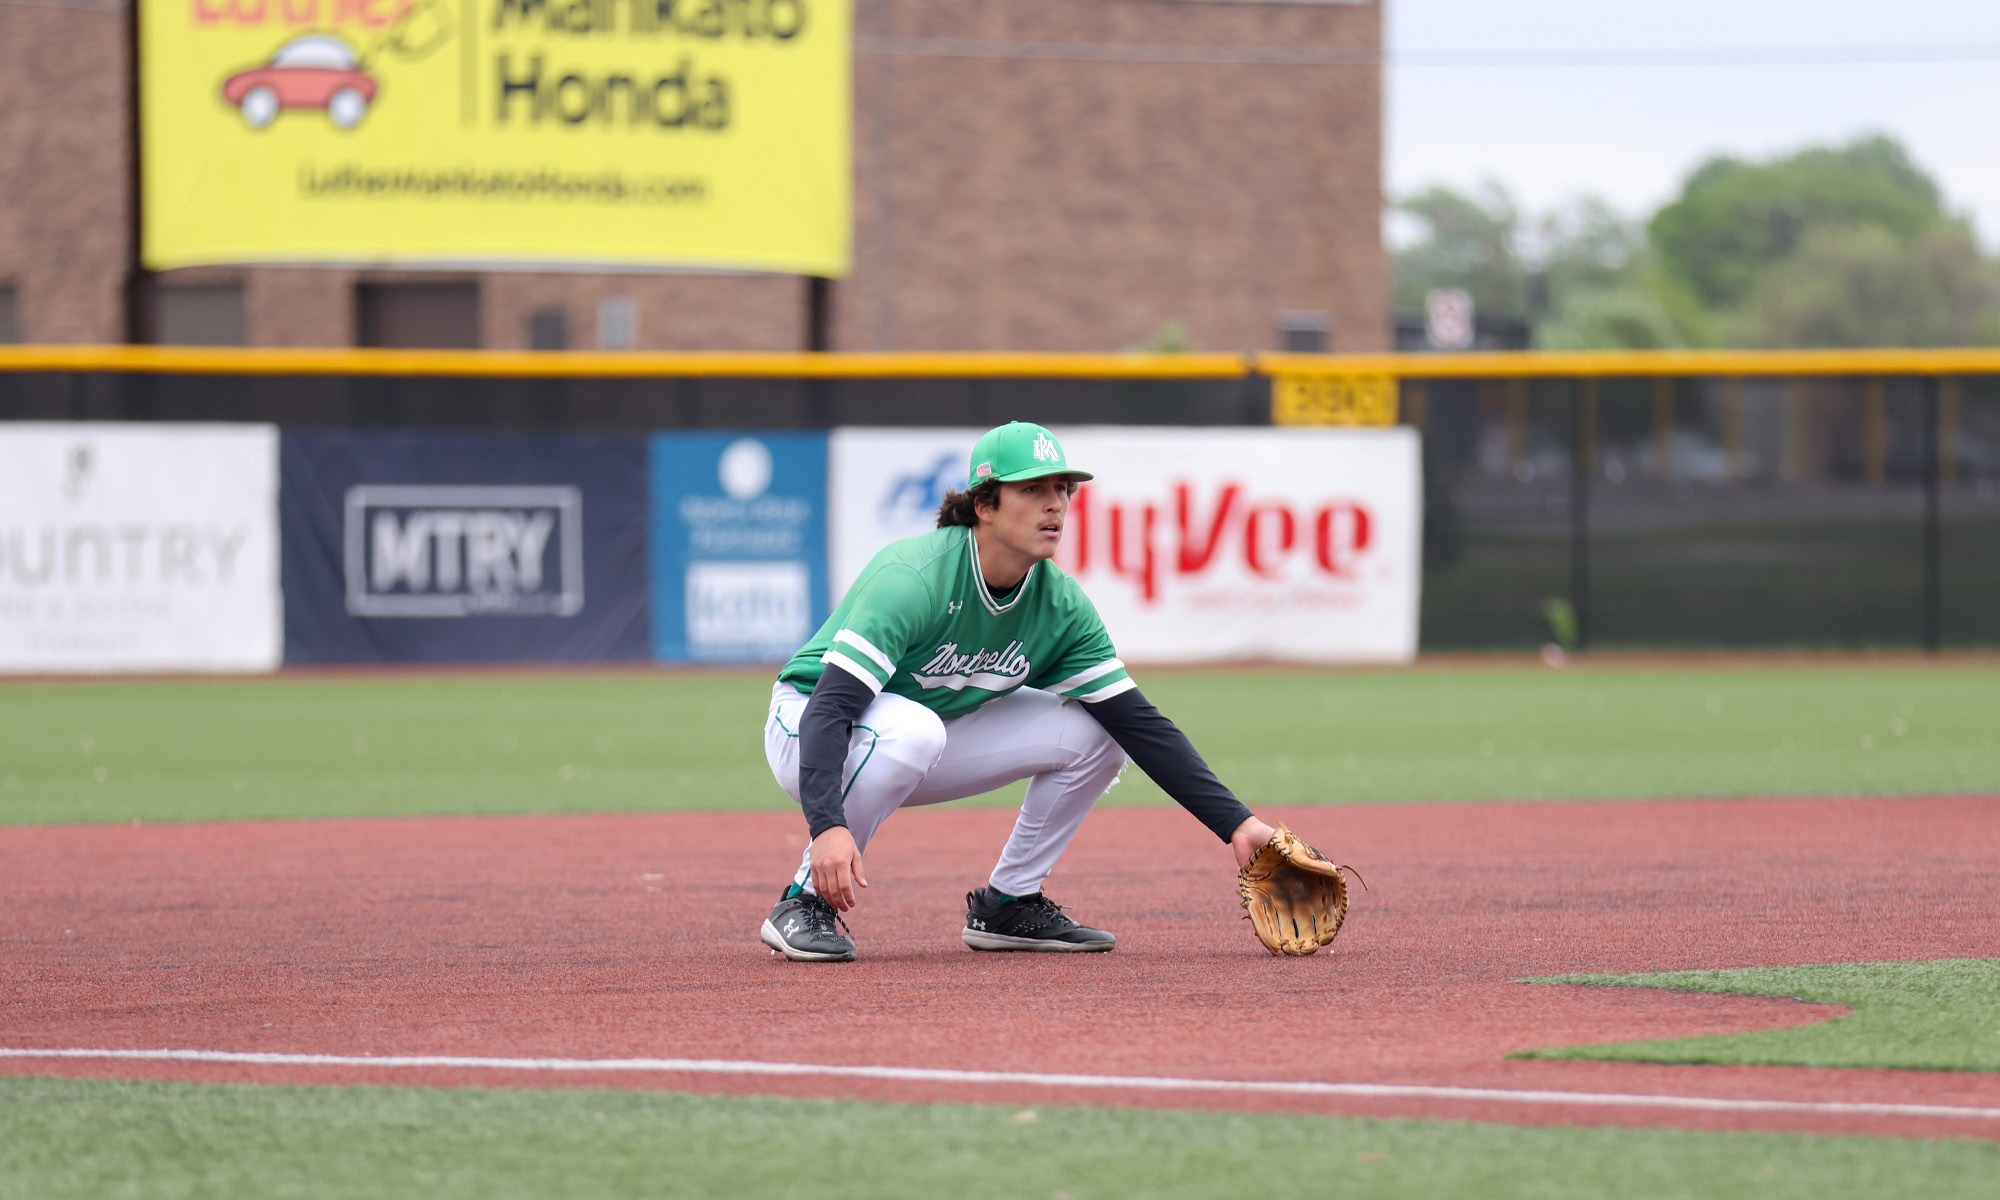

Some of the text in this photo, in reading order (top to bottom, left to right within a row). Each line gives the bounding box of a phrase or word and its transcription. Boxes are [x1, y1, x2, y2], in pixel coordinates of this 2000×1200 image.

[494, 52, 732, 130] Honda
[0, 522, 250, 588] UNTRY
[371, 511, 554, 593] MTRY
